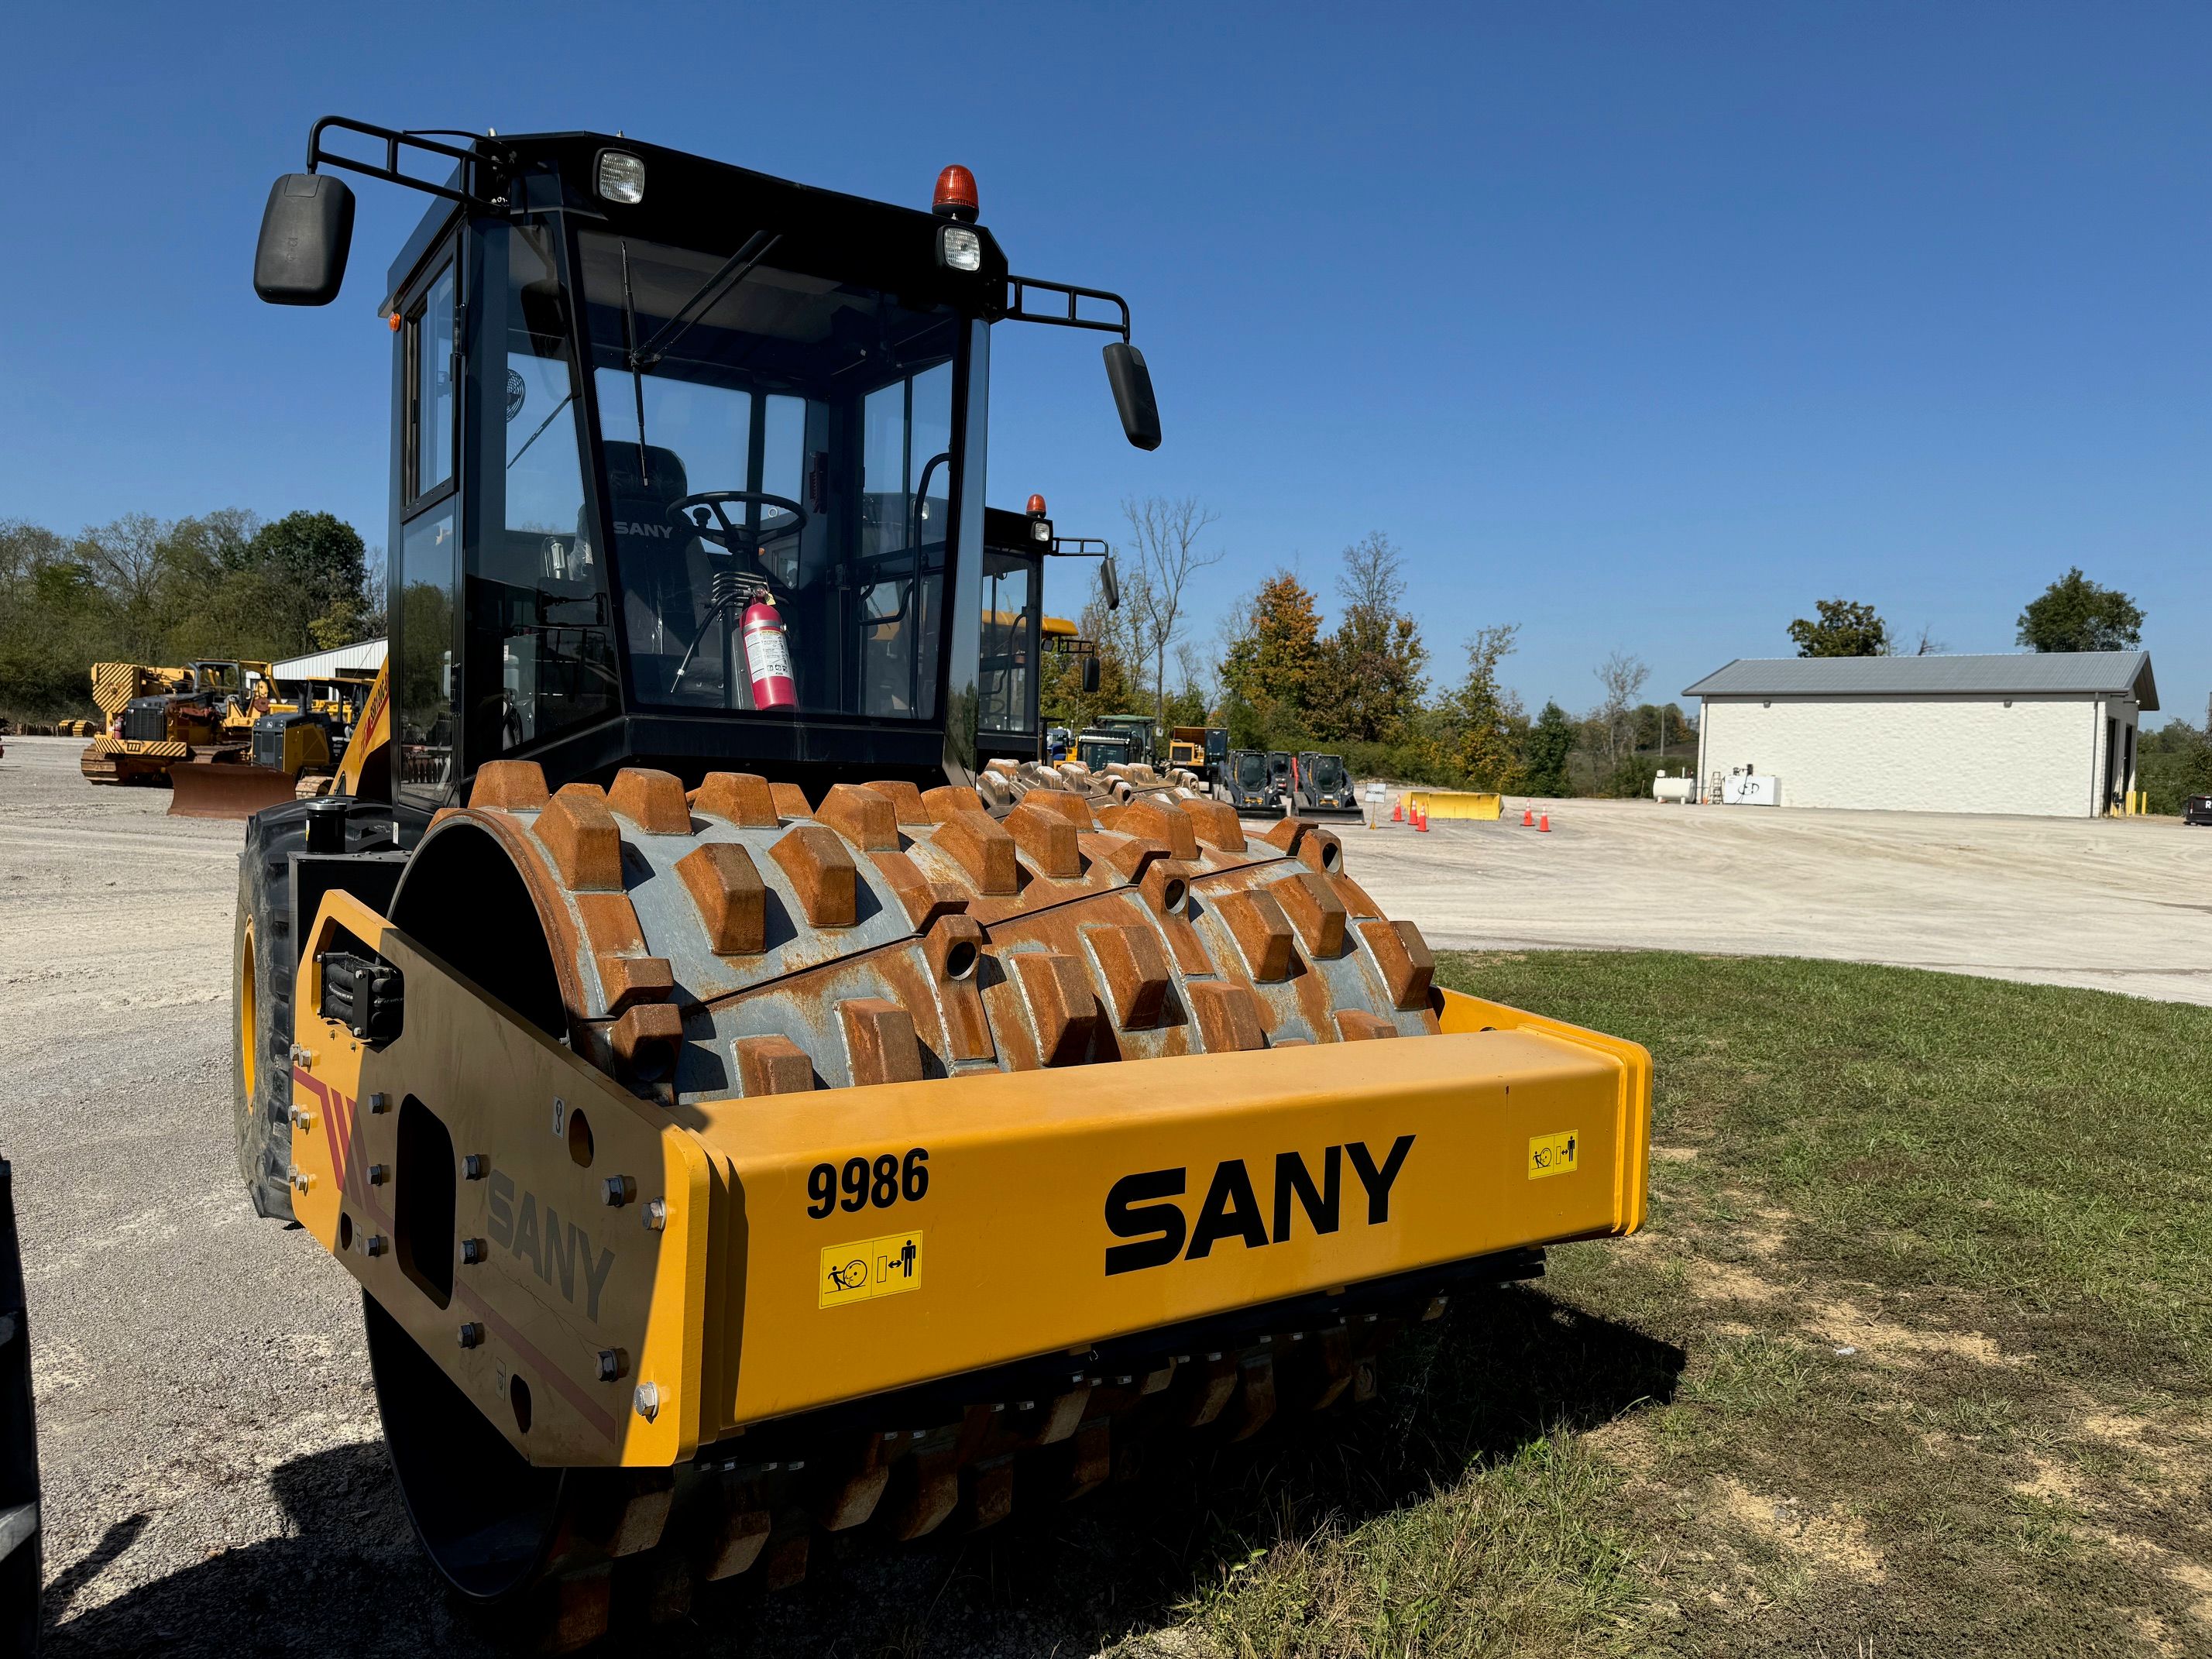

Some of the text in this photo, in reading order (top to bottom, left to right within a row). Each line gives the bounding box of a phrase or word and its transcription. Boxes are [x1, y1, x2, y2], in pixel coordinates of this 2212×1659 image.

[613, 520, 673, 538] SANY
[807, 1147, 929, 1220] 9986
[1104, 1134, 1417, 1276] SANY
[487, 1169, 616, 1324] SANY
